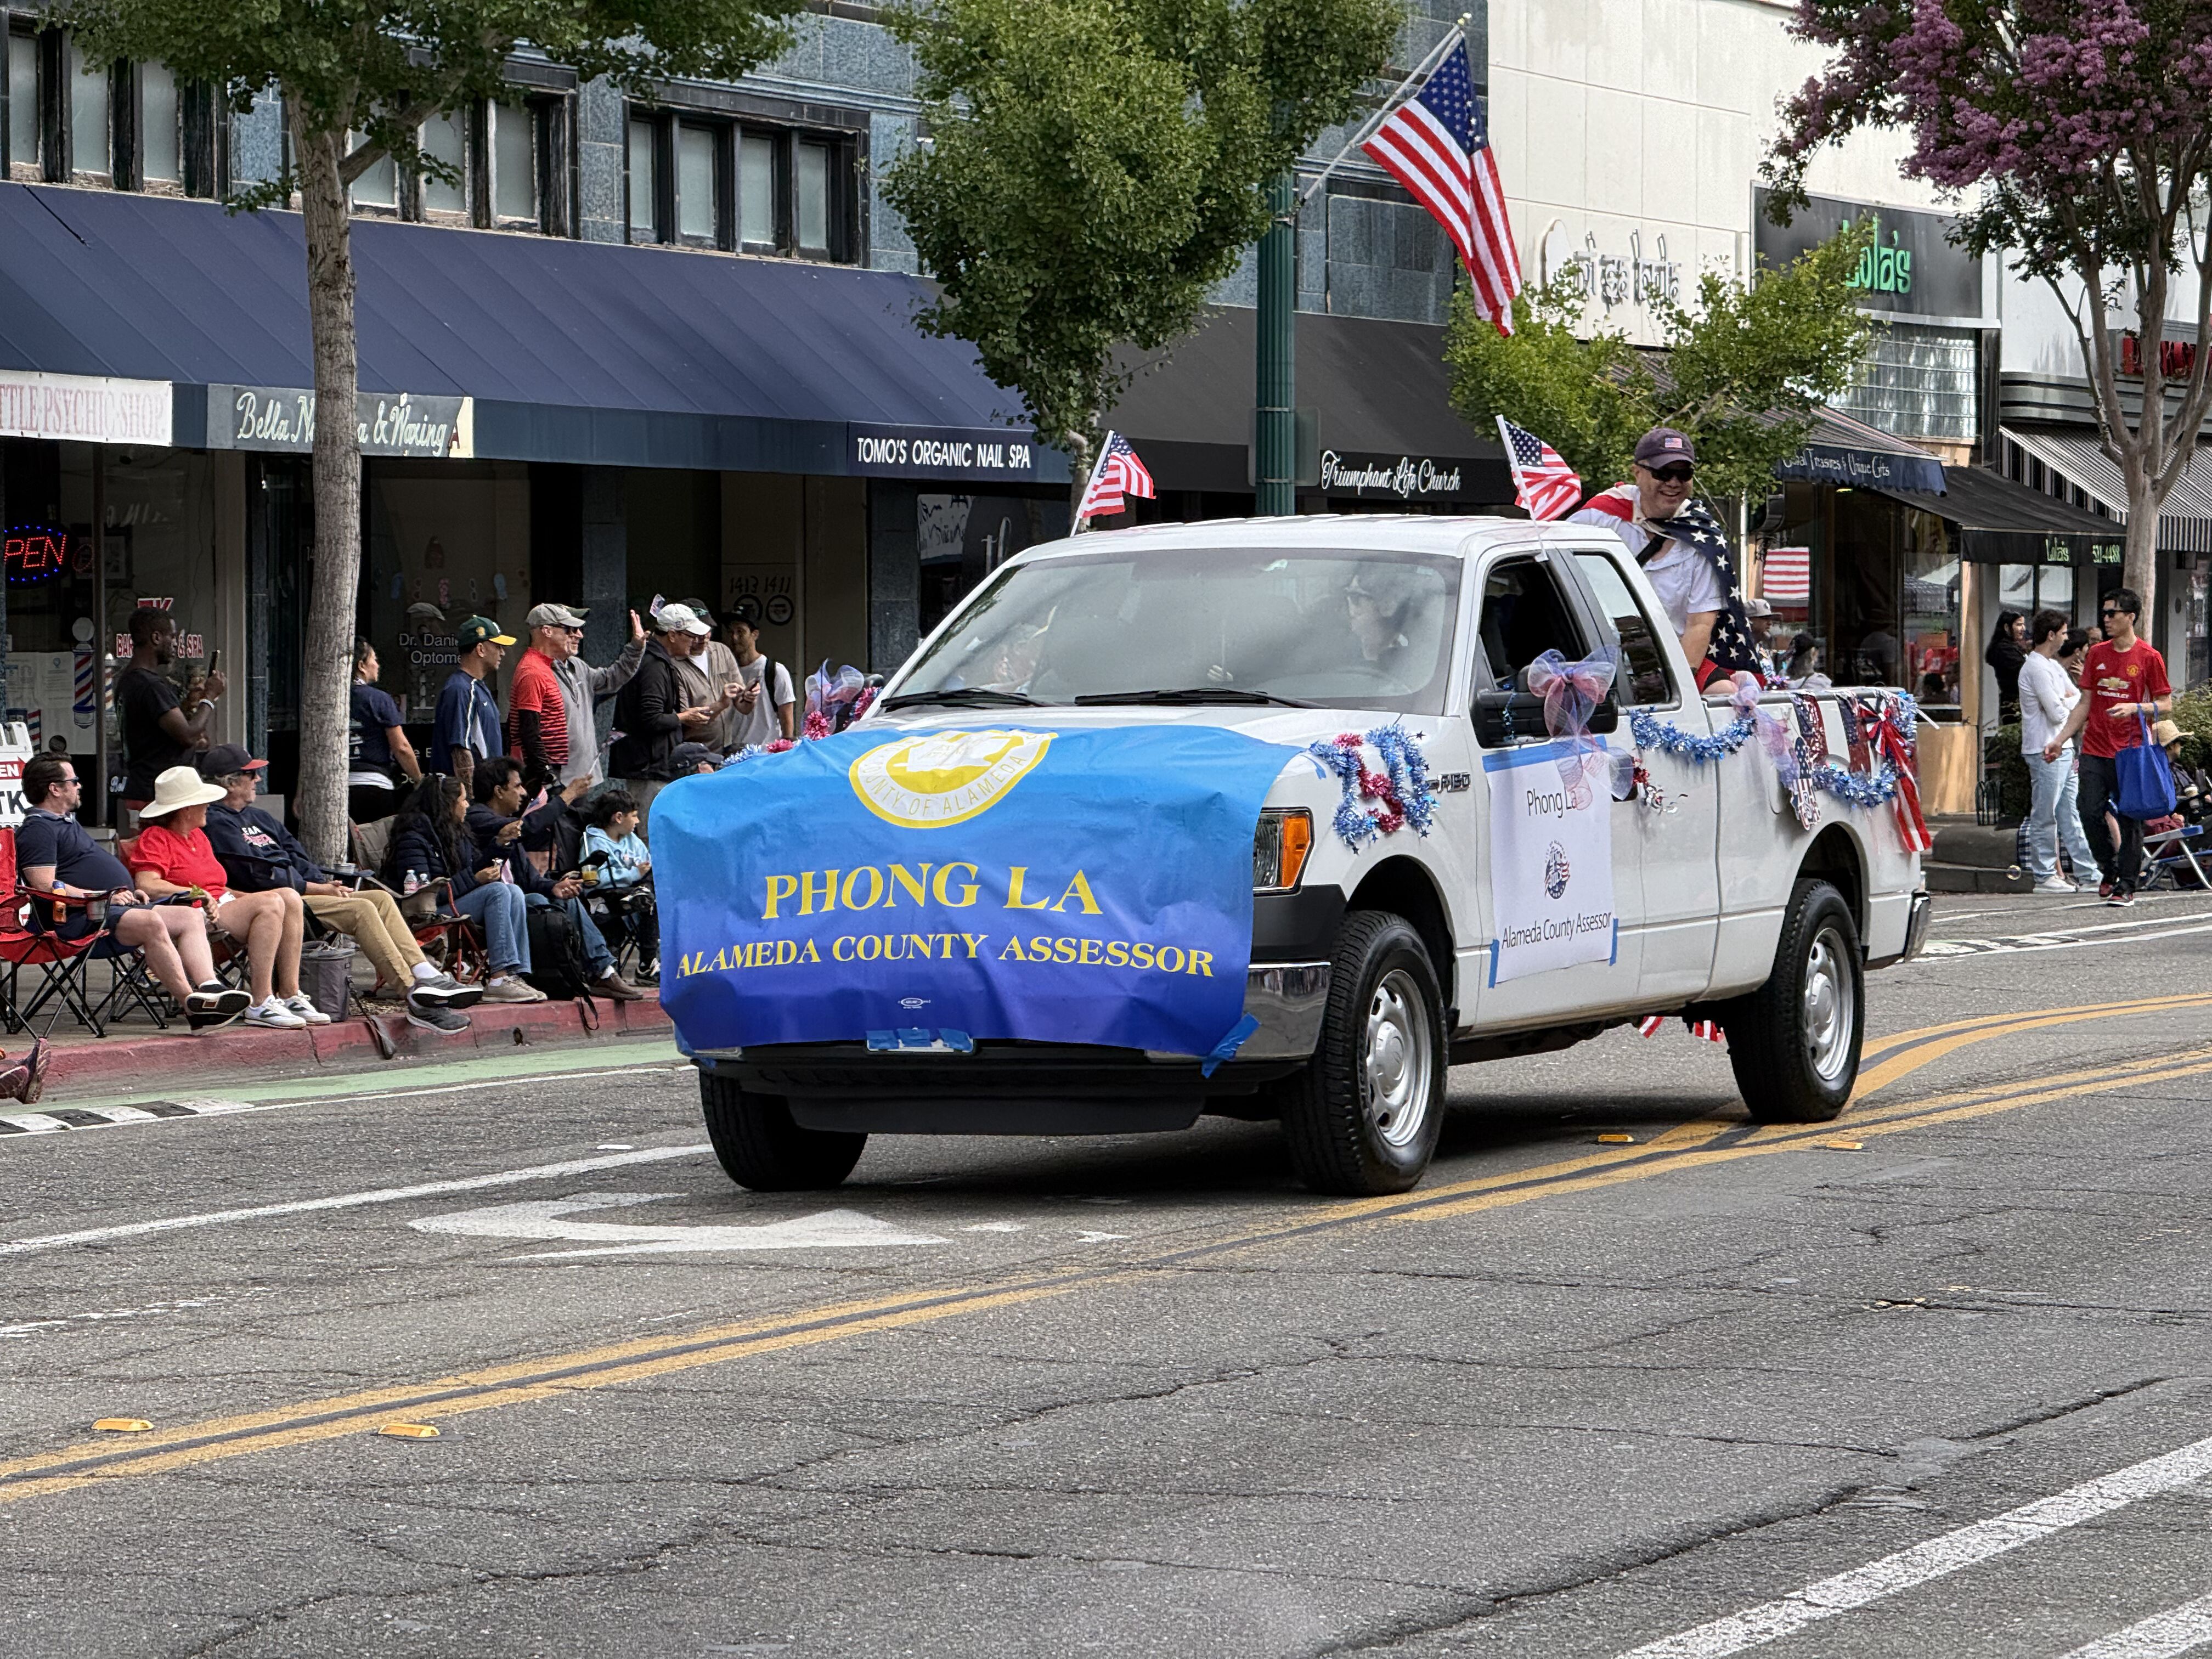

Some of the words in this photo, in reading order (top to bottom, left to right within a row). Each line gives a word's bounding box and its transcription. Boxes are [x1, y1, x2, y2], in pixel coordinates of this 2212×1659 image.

[43, 386, 116, 437] PSYCHIC
[236, 392, 289, 441] Bella
[390, 404, 447, 457] Waxing
[857, 438, 907, 464] TOMO'S
[912, 440, 972, 467] ORGANIC
[977, 444, 1005, 467] NAIL
[1008, 444, 1030, 468] SPA
[1321, 450, 1394, 495] Triumphant
[1392, 456, 1417, 498] Life
[1418, 459, 1462, 493] Church
[187, 634, 204, 658] SPA
[399, 633, 417, 646] Dr.
[909, 798, 933, 816] OF
[943, 755, 1027, 815] ALAMEDA
[1527, 788, 1563, 819] Phong
[1564, 786, 1577, 810] La
[761, 862, 981, 919] PHONG
[1002, 866, 1103, 915] LA
[1502, 921, 1541, 949] Alameda
[1543, 917, 1575, 941] County
[1576, 912, 1612, 934] Assessor
[675, 937, 821, 980] ALAMEDA
[832, 933, 989, 962] COUNTY
[997, 935, 1214, 978] ASSESSOR
